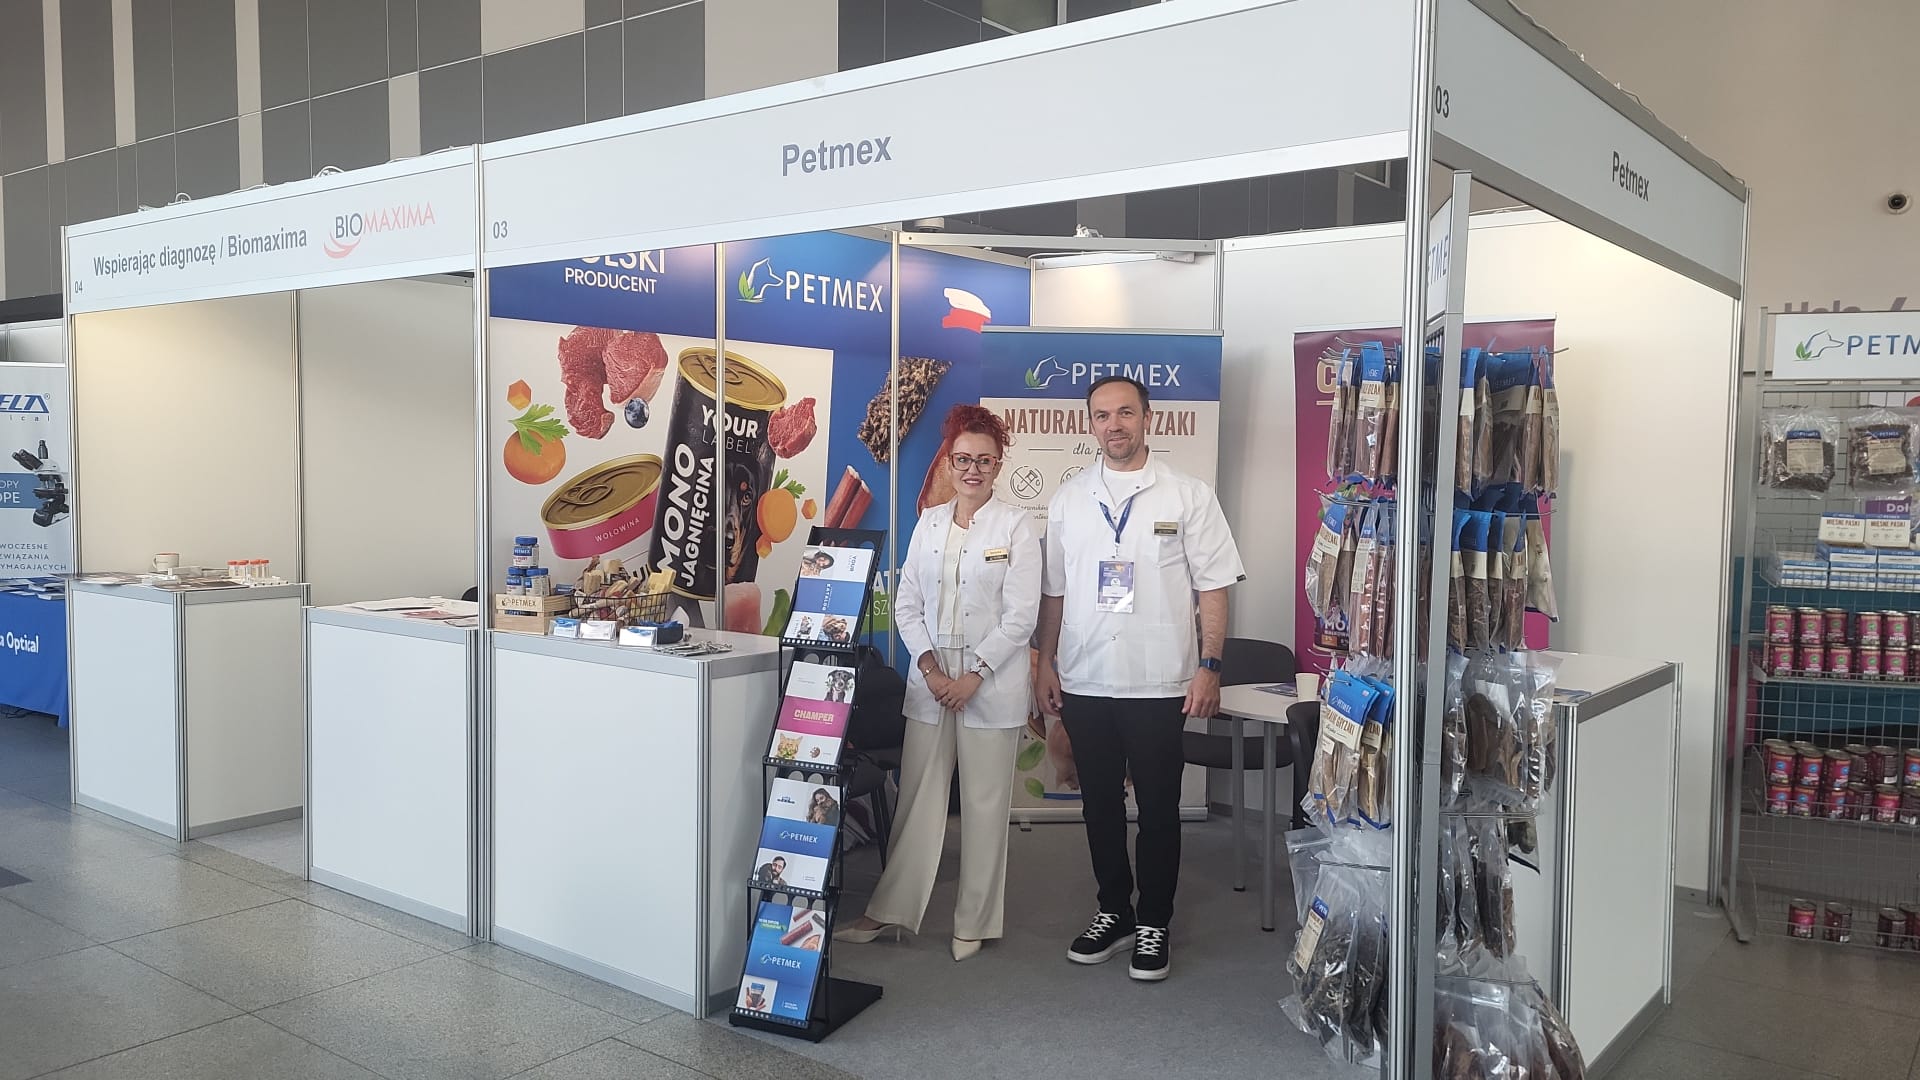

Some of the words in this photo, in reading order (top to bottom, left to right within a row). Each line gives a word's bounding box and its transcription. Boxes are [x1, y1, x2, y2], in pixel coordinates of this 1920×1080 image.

[1434, 85, 1450, 118] 03
[782, 136, 892, 177] Petmex
[1612, 150, 1650, 202] Petmex
[335, 201, 436, 239] BIOMAXIMA
[492, 220, 508, 239] 03
[93, 250, 156, 279] Wspierając
[159, 243, 216, 270] diagnozę
[219, 236, 224, 259] /
[228, 227, 307, 257] Biomaxima
[74, 280, 83, 294] 04
[564, 266, 658, 294] PRODUCENT
[785, 270, 884, 313] PETMEX
[1847, 334, 1920, 356] PETM
[1071, 362, 1181, 387] PETMEX
[702, 404, 759, 439] YOUR
[1004, 408, 1096, 435] NATURAL
[1072, 442, 1093, 455] dla
[657, 443, 695, 572] MONO
[680, 457, 714, 587] JAGNIĘCINA
[511, 599, 537, 608] PETMEX
[6, 631, 39, 656] Optical
[794, 709, 835, 723] CHAMPER
[790, 832, 819, 844] PETMEX
[771, 956, 802, 970] PETMEX
